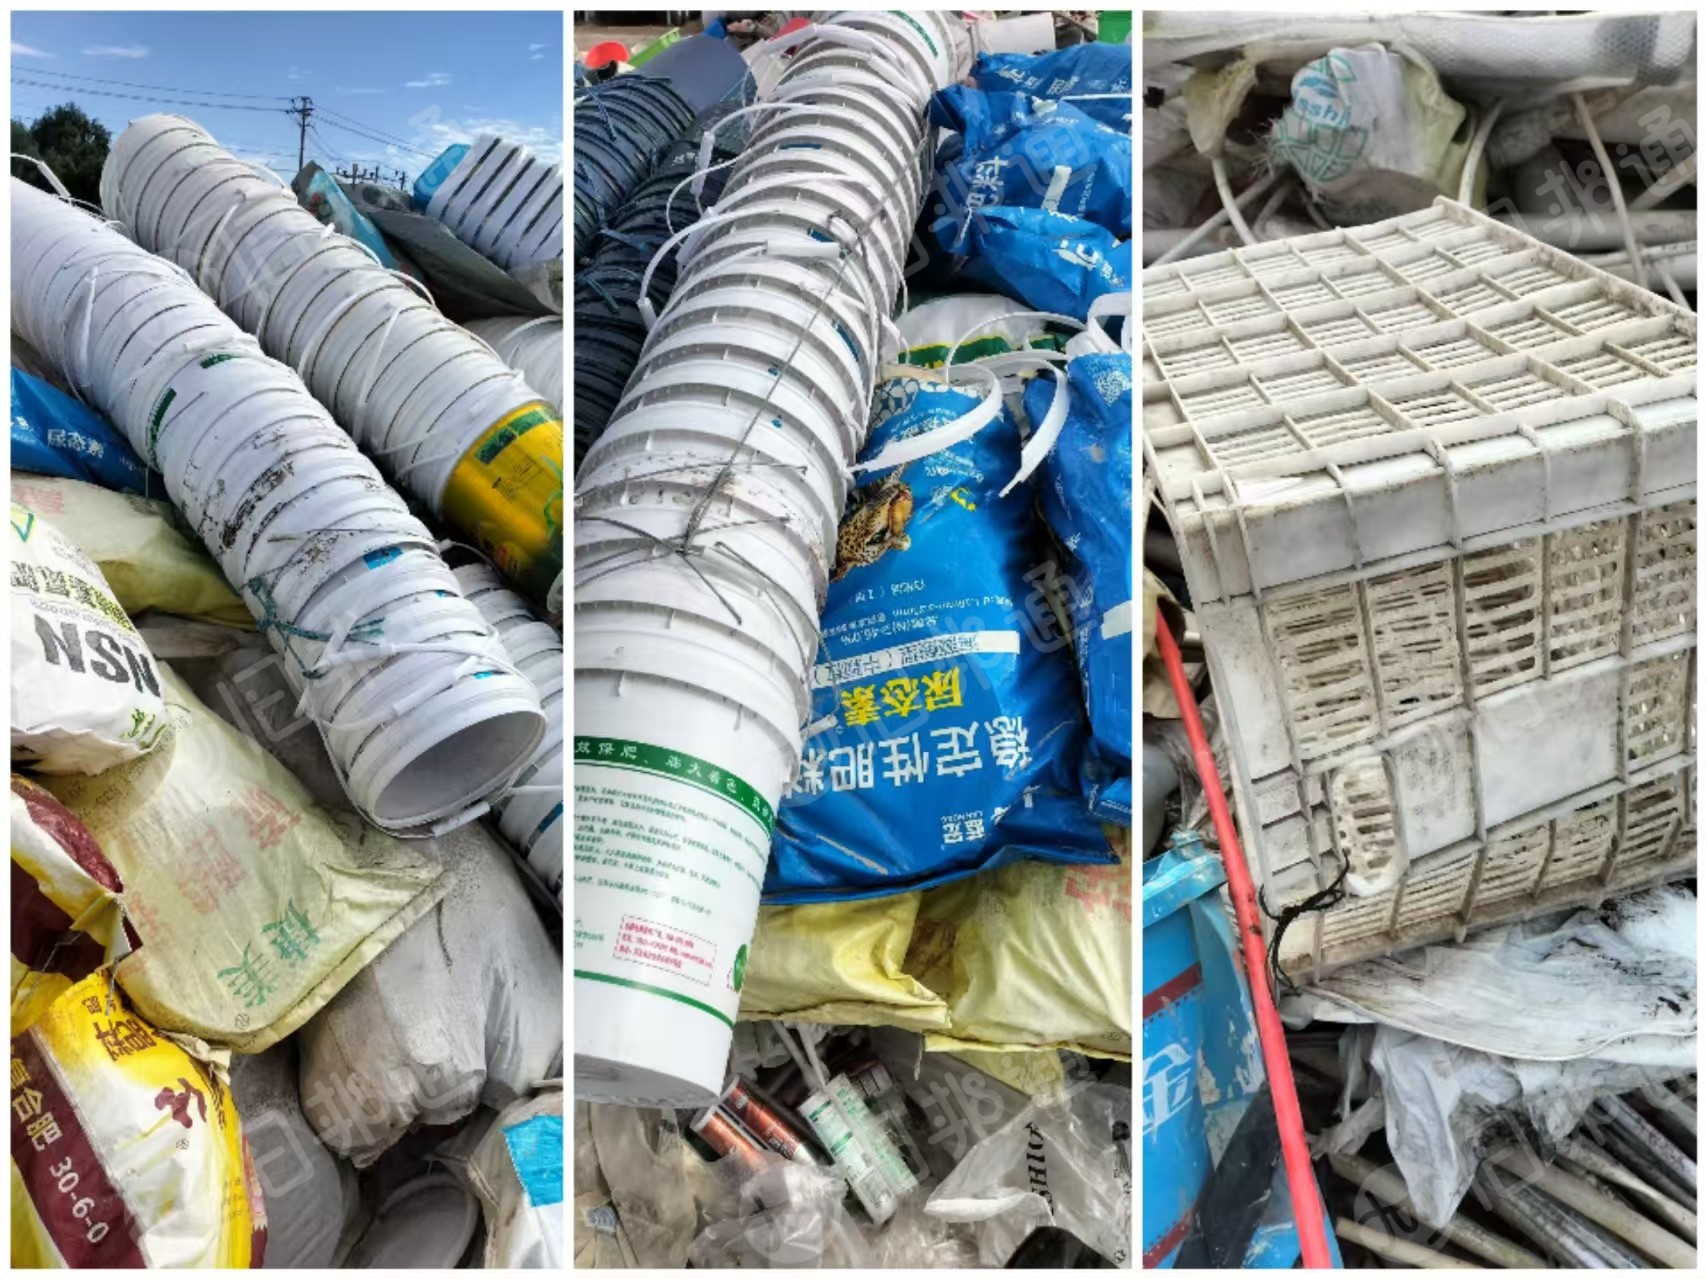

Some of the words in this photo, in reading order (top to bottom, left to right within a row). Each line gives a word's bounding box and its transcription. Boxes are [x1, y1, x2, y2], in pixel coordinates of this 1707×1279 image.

[33, 612, 161, 698] NSN
[841, 666, 963, 726] 尿态素
[783, 715, 1032, 800] 稳定性肥料
[49, 1155, 110, 1243] 30-6-0
